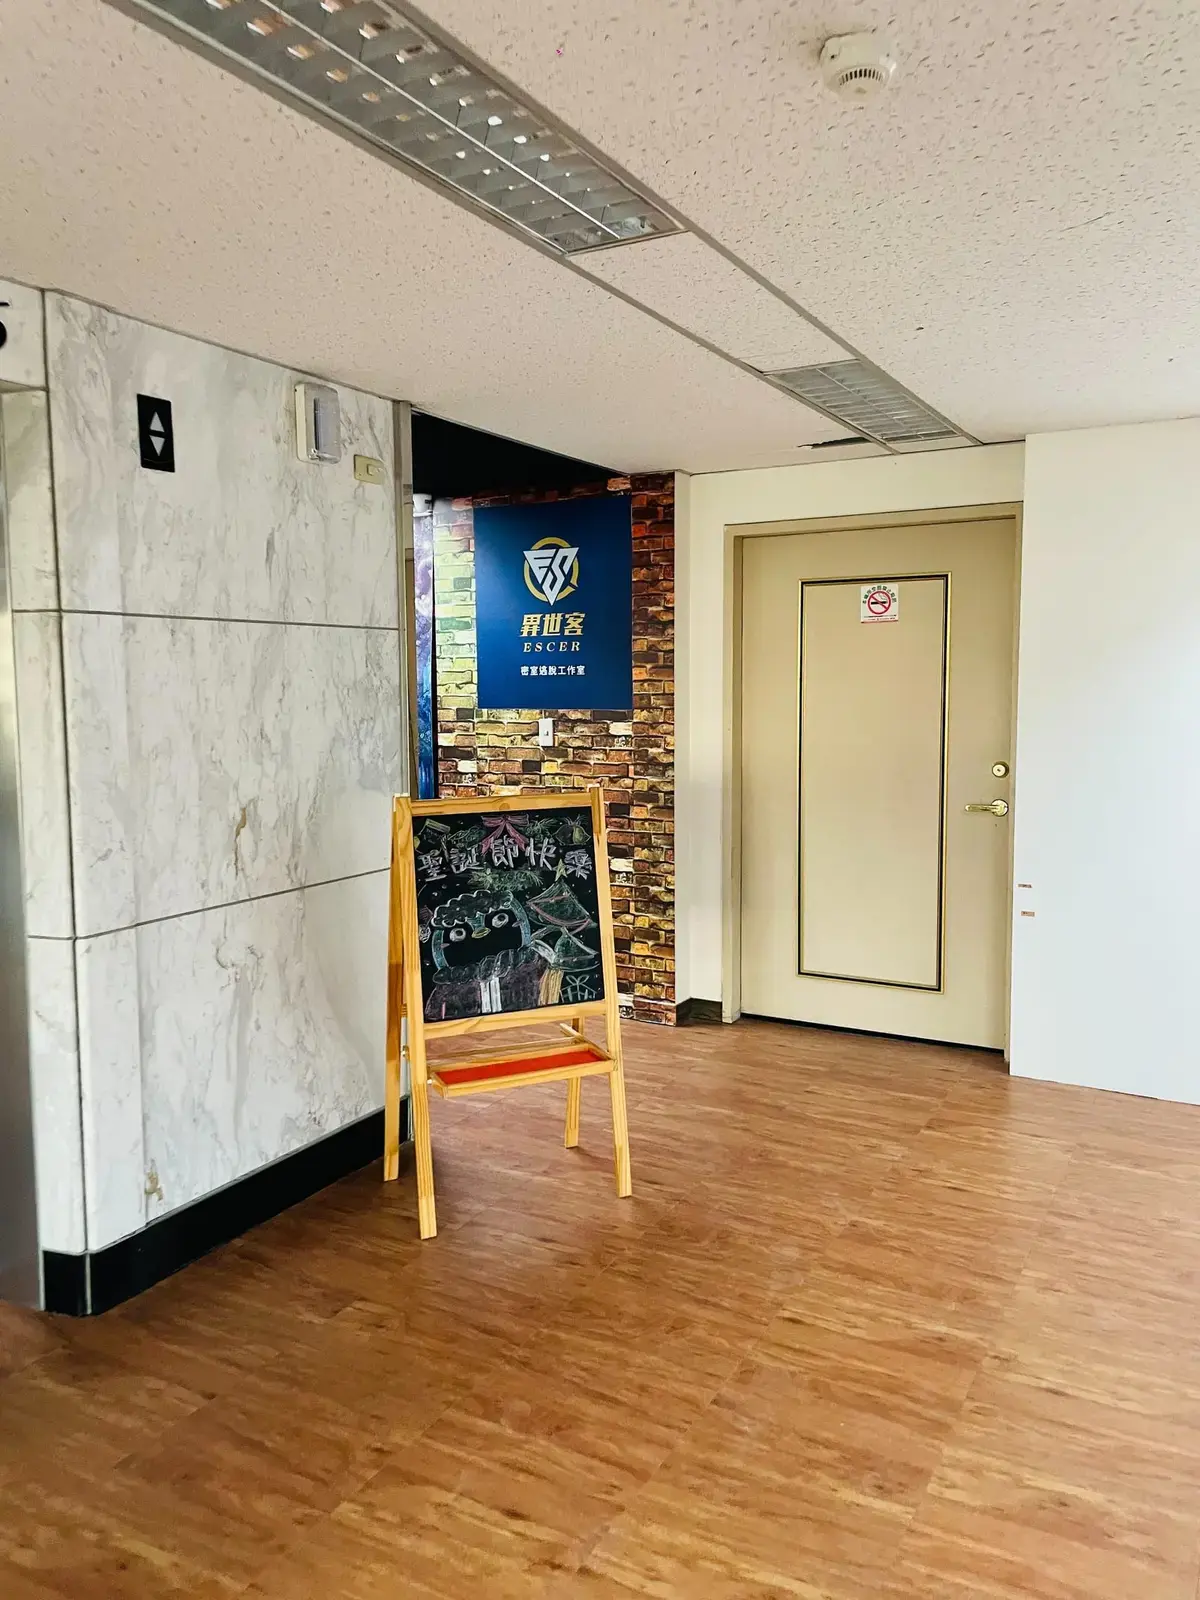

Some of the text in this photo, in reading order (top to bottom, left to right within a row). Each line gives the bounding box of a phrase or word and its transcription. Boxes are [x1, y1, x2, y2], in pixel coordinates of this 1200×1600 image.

[523, 641, 581, 653] ESCER
[417, 834, 593, 882] 聖誕節快樂
